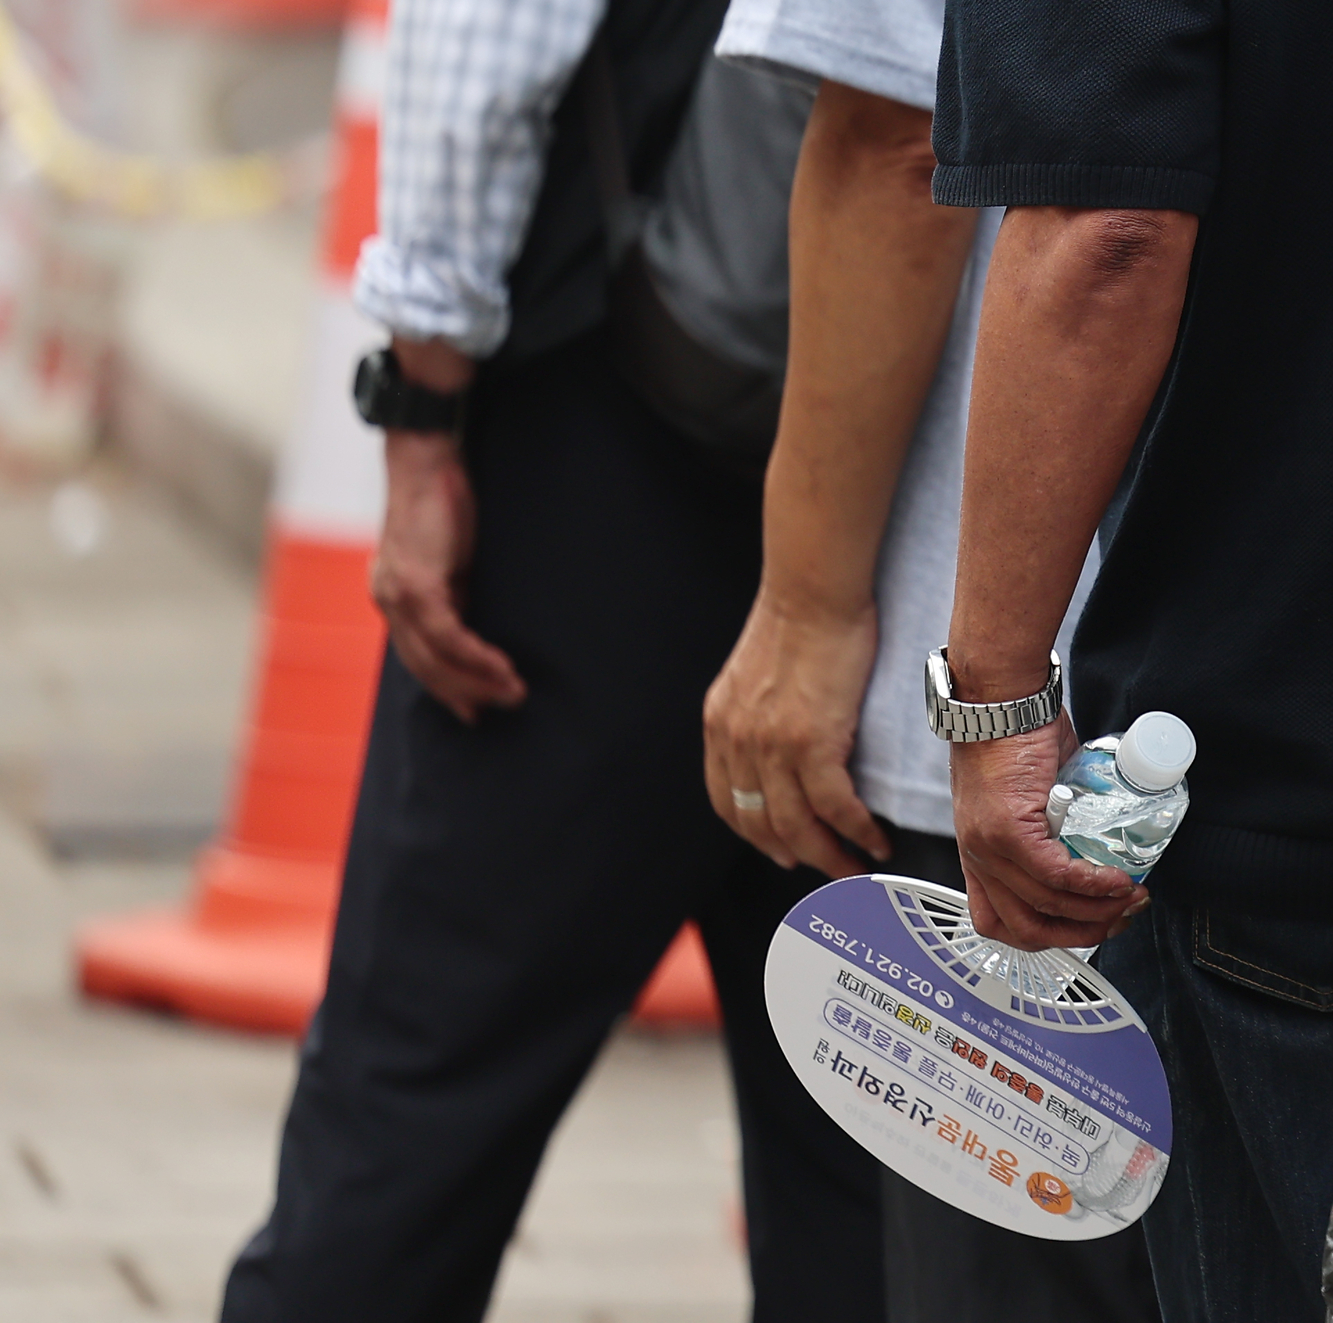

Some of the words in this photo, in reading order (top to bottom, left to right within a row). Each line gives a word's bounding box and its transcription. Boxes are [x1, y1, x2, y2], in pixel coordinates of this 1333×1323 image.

[808, 913, 934, 998] 02.921.7582
[836, 969, 933, 1036] 신경입니다!
[961, 1011, 978, 1026] 4층
[832, 1004, 913, 1064] 통증탈출
[933, 1025, 989, 1071] 원인은
[988, 1060, 1045, 1106] 통증의
[1081, 1085, 1100, 1102] 출구
[1099, 1094, 1116, 1112] 5번
[1045, 1094, 1102, 1141] 대부분
[1115, 1104, 1152, 1133] 신설동역
